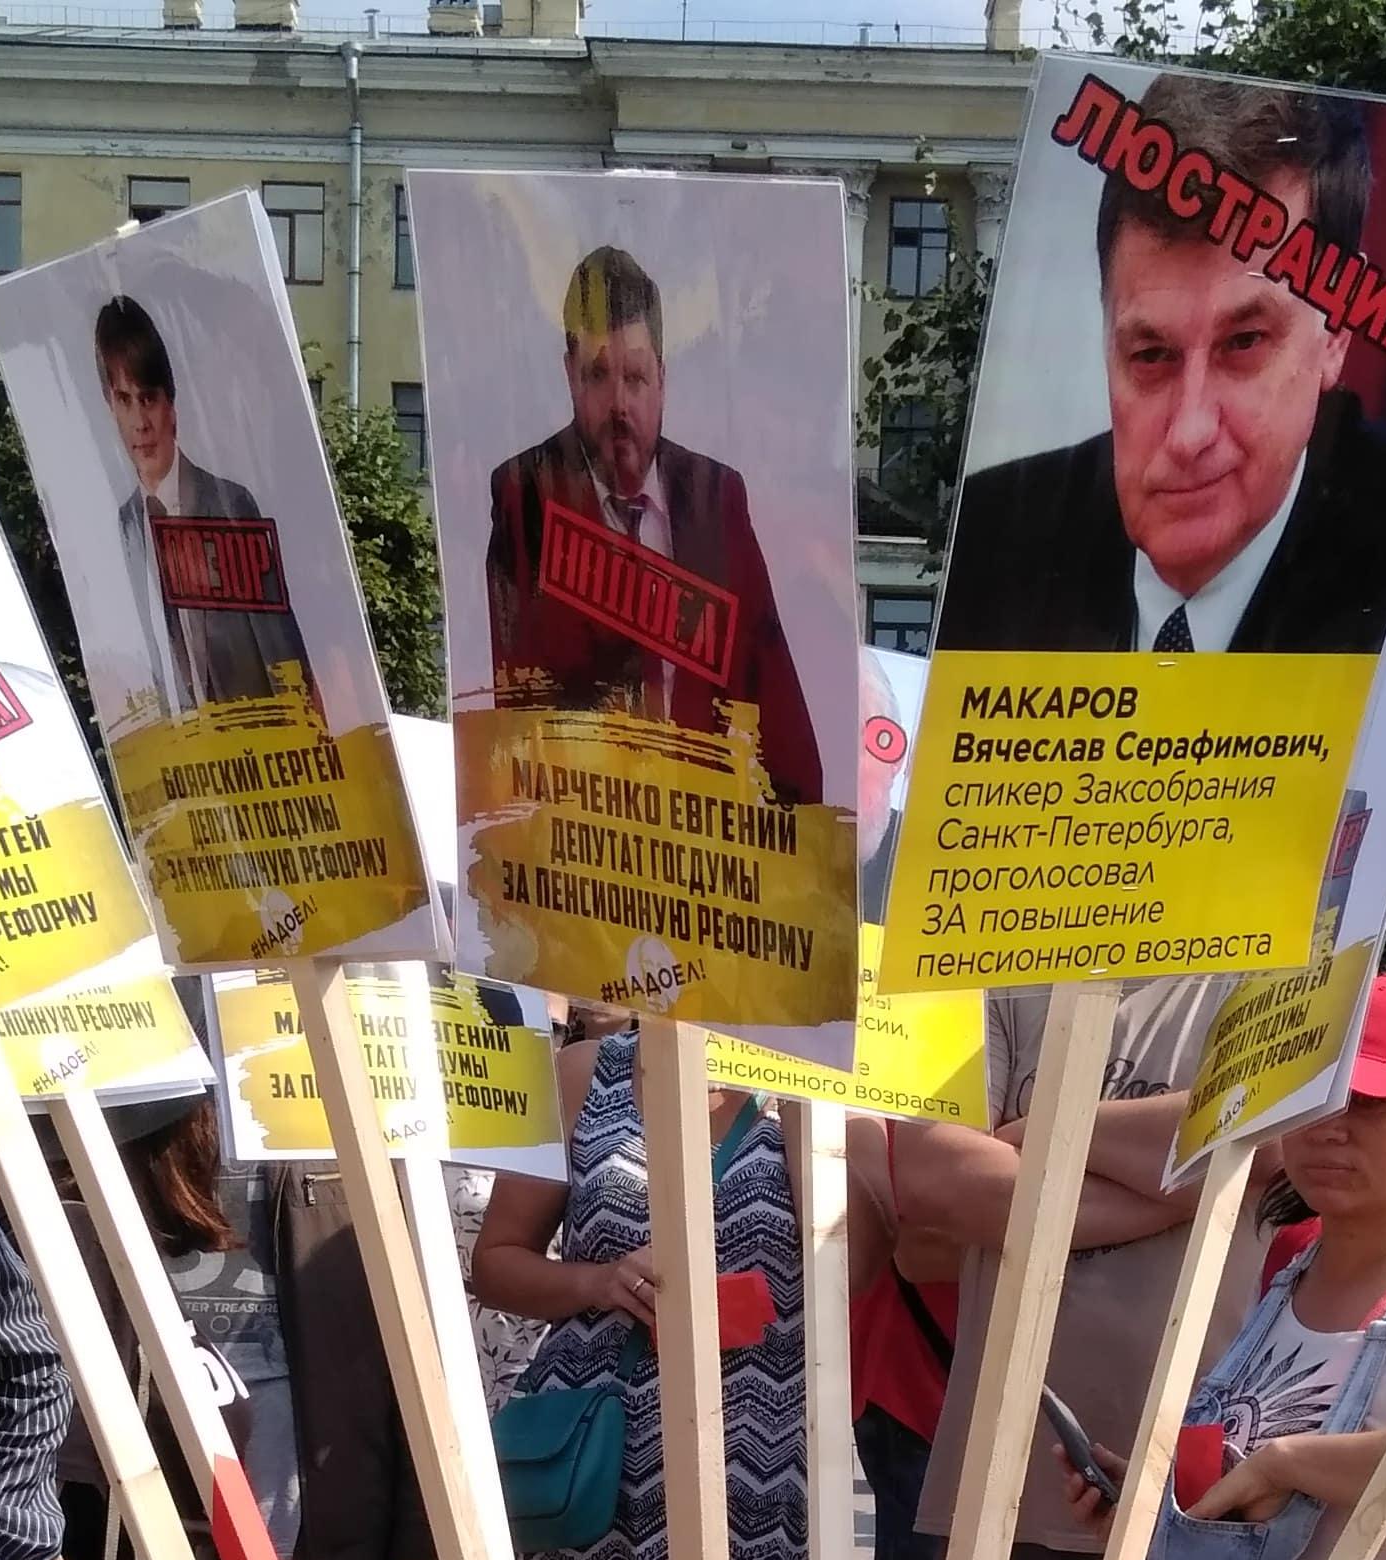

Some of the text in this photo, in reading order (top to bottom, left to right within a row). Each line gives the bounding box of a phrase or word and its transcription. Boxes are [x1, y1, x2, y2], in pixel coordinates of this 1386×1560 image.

[163, 529, 270, 599] ПОЗОР
[548, 522, 716, 663] НАДОЕЛ
[960, 687, 1138, 720] МАКАРОВ
[161, 738, 345, 800] БОЯРСКИЙ СЕРГЕЙ
[952, 729, 1329, 767] Вячеслав Серафимович,
[513, 759, 796, 856] МАРЧЕНКО ЕВГЕНИЙ
[945, 769, 1275, 810] спикер Заксобрания
[187, 794, 341, 850] ДЕПУТАТ ГОСДУМЫ
[937, 814, 1235, 852] Санкт-Петербурга,
[167, 858, 190, 893] ЗА
[300, 837, 387, 883] РЕФОРМУ
[550, 818, 761, 904] ДЕПУТАТ ГОСДУМЫ
[928, 859, 1154, 898] проголосовал
[251, 895, 318, 959] #НАДОЕЛ!
[503, 861, 813, 973] ЗА ПЕНСИОННУЮ РЕФОРМУ
[921, 899, 1165, 936] ЗА повышение
[916, 942, 1125, 978] пенсионного
[1136, 932, 1272, 968] возраста
[601, 960, 706, 1004] #НАДОЕЛ!
[80, 1001, 156, 1032] РЕФОРМУ
[1251, 999, 1311, 1047] ГОСДУМЫ
[33, 1041, 100, 1094] #НАДОЕЛ!
[1263, 1022, 1329, 1071] РЕФОРМУ
[270, 1074, 296, 1098] ЗА
[445, 1081, 527, 1116] РЕФОРМУ
[706, 1057, 846, 1095] енсионного
[856, 1085, 961, 1118] возраста
